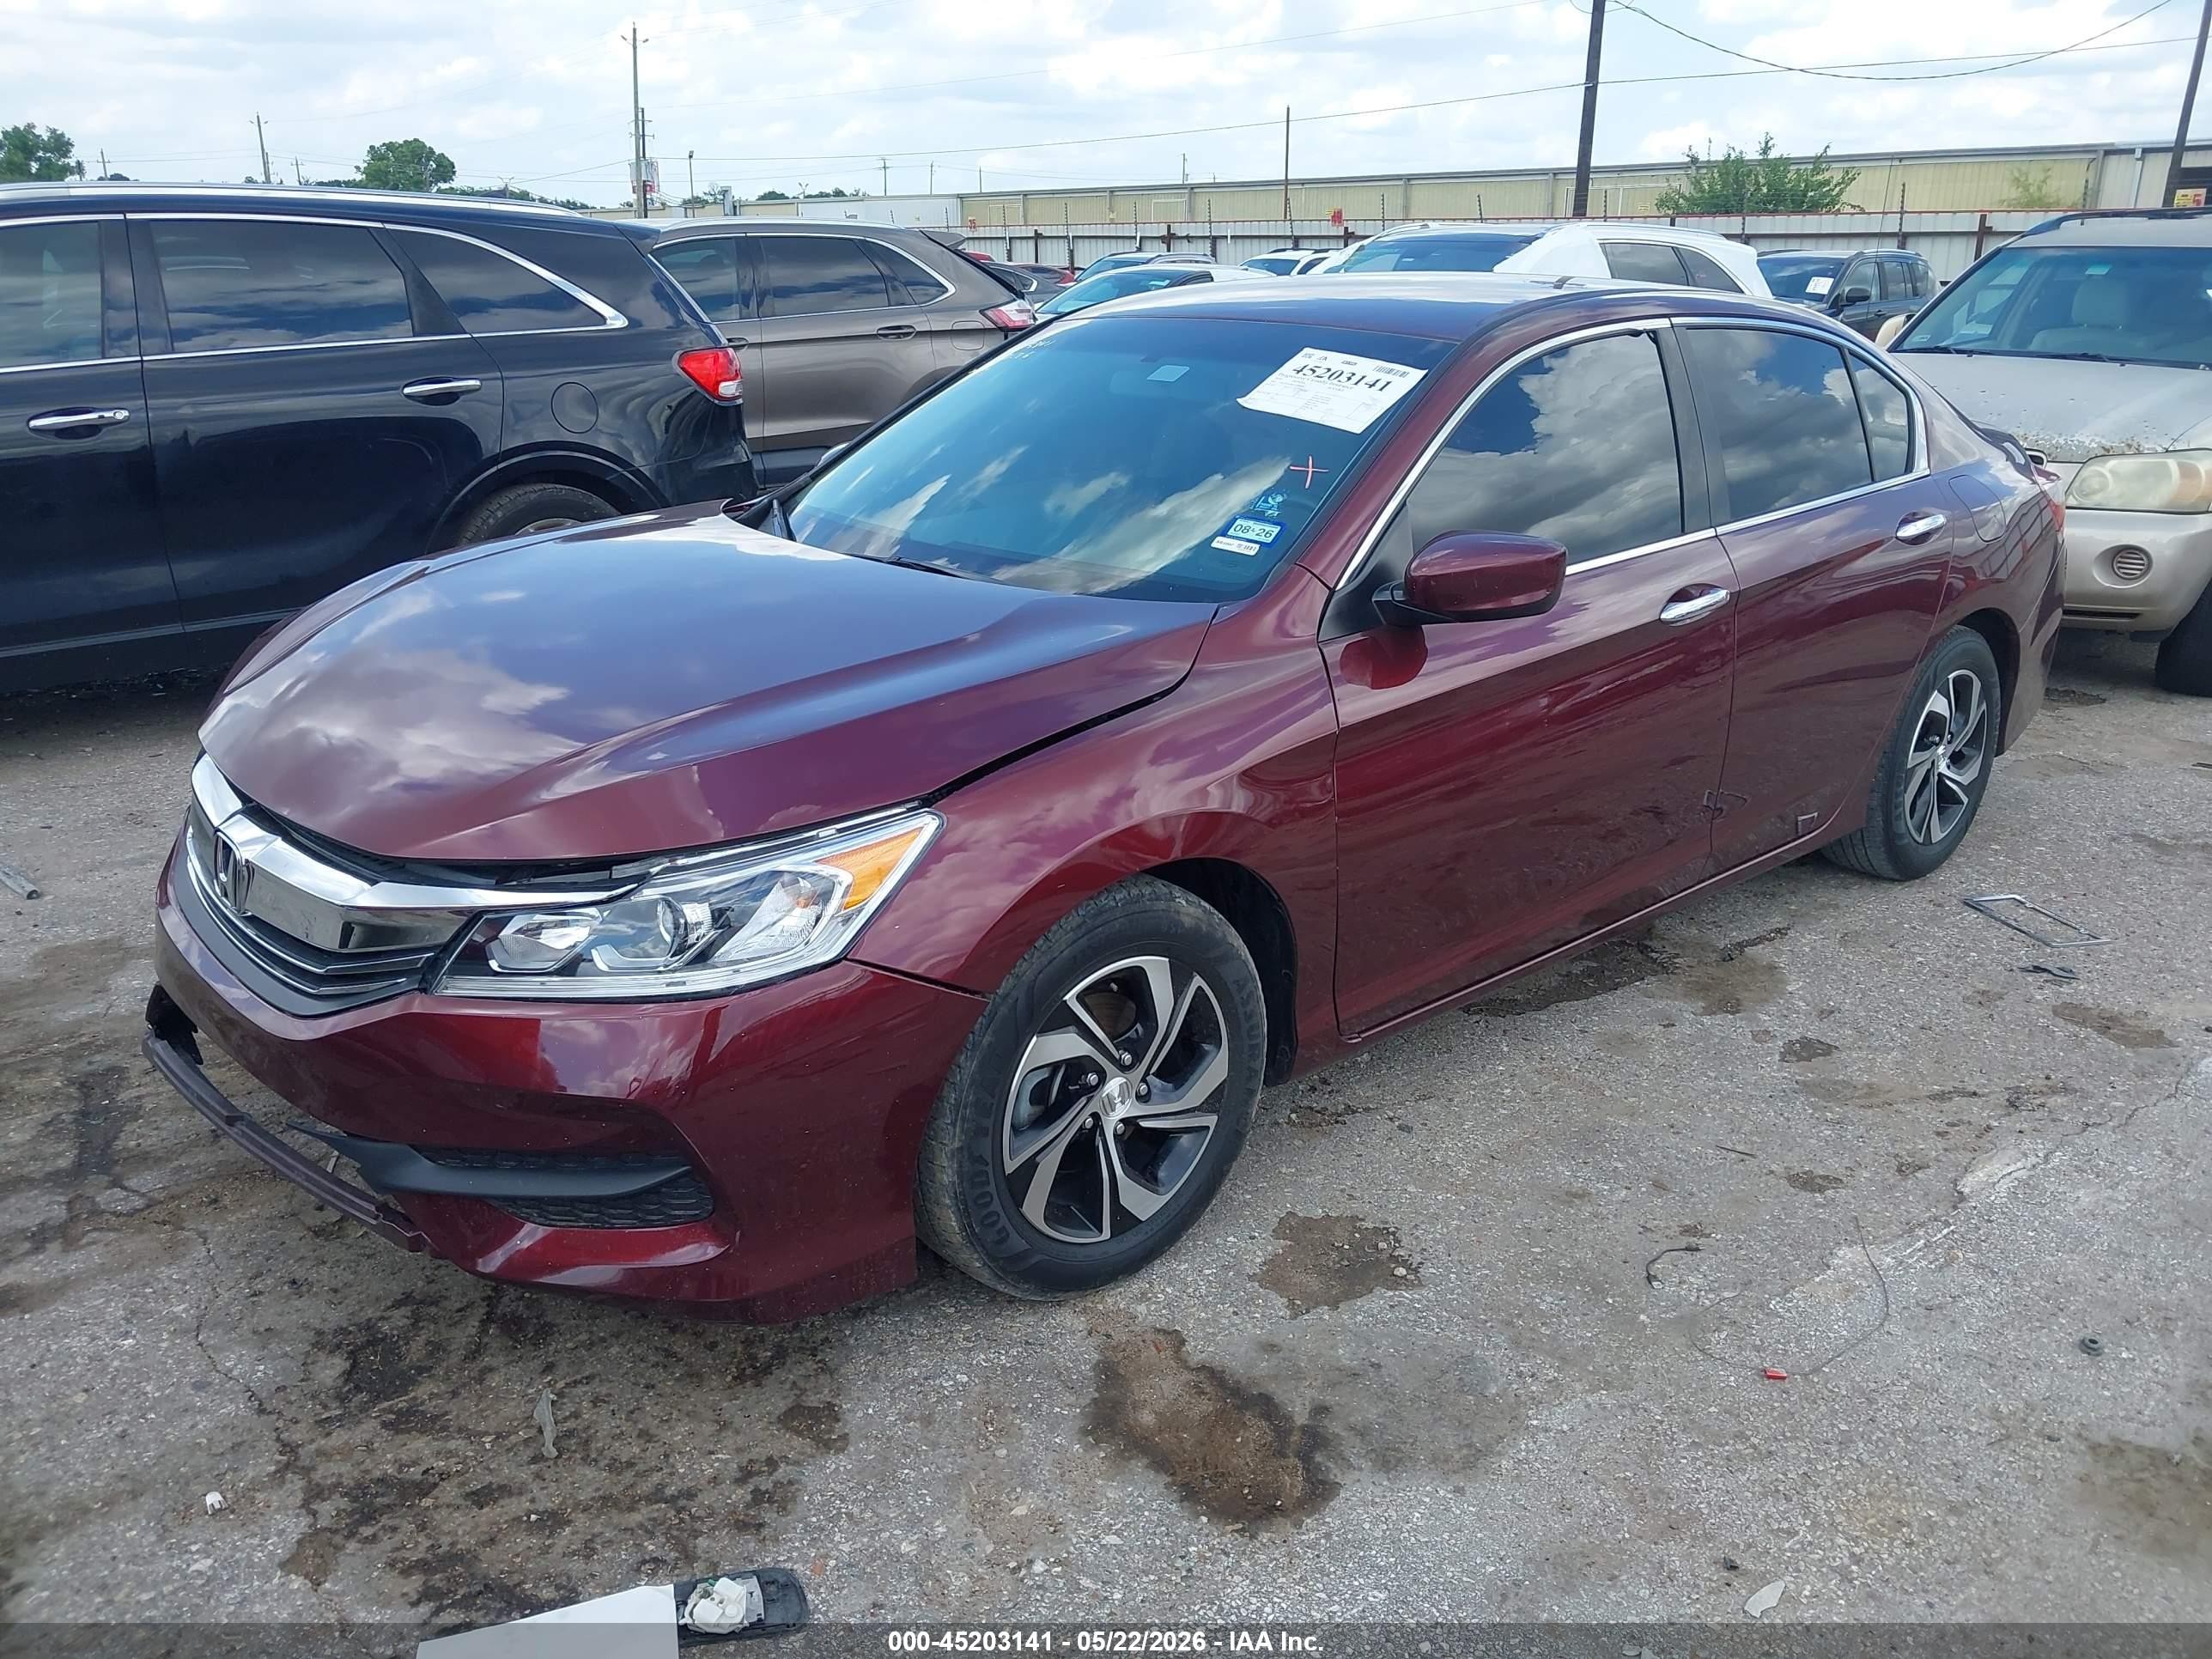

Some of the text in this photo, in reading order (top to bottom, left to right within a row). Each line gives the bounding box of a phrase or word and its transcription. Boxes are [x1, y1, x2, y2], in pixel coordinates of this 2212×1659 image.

[1292, 364, 1392, 392] 45203141
[1233, 524, 1251, 534] 08
[1255, 527, 1274, 538] 26
